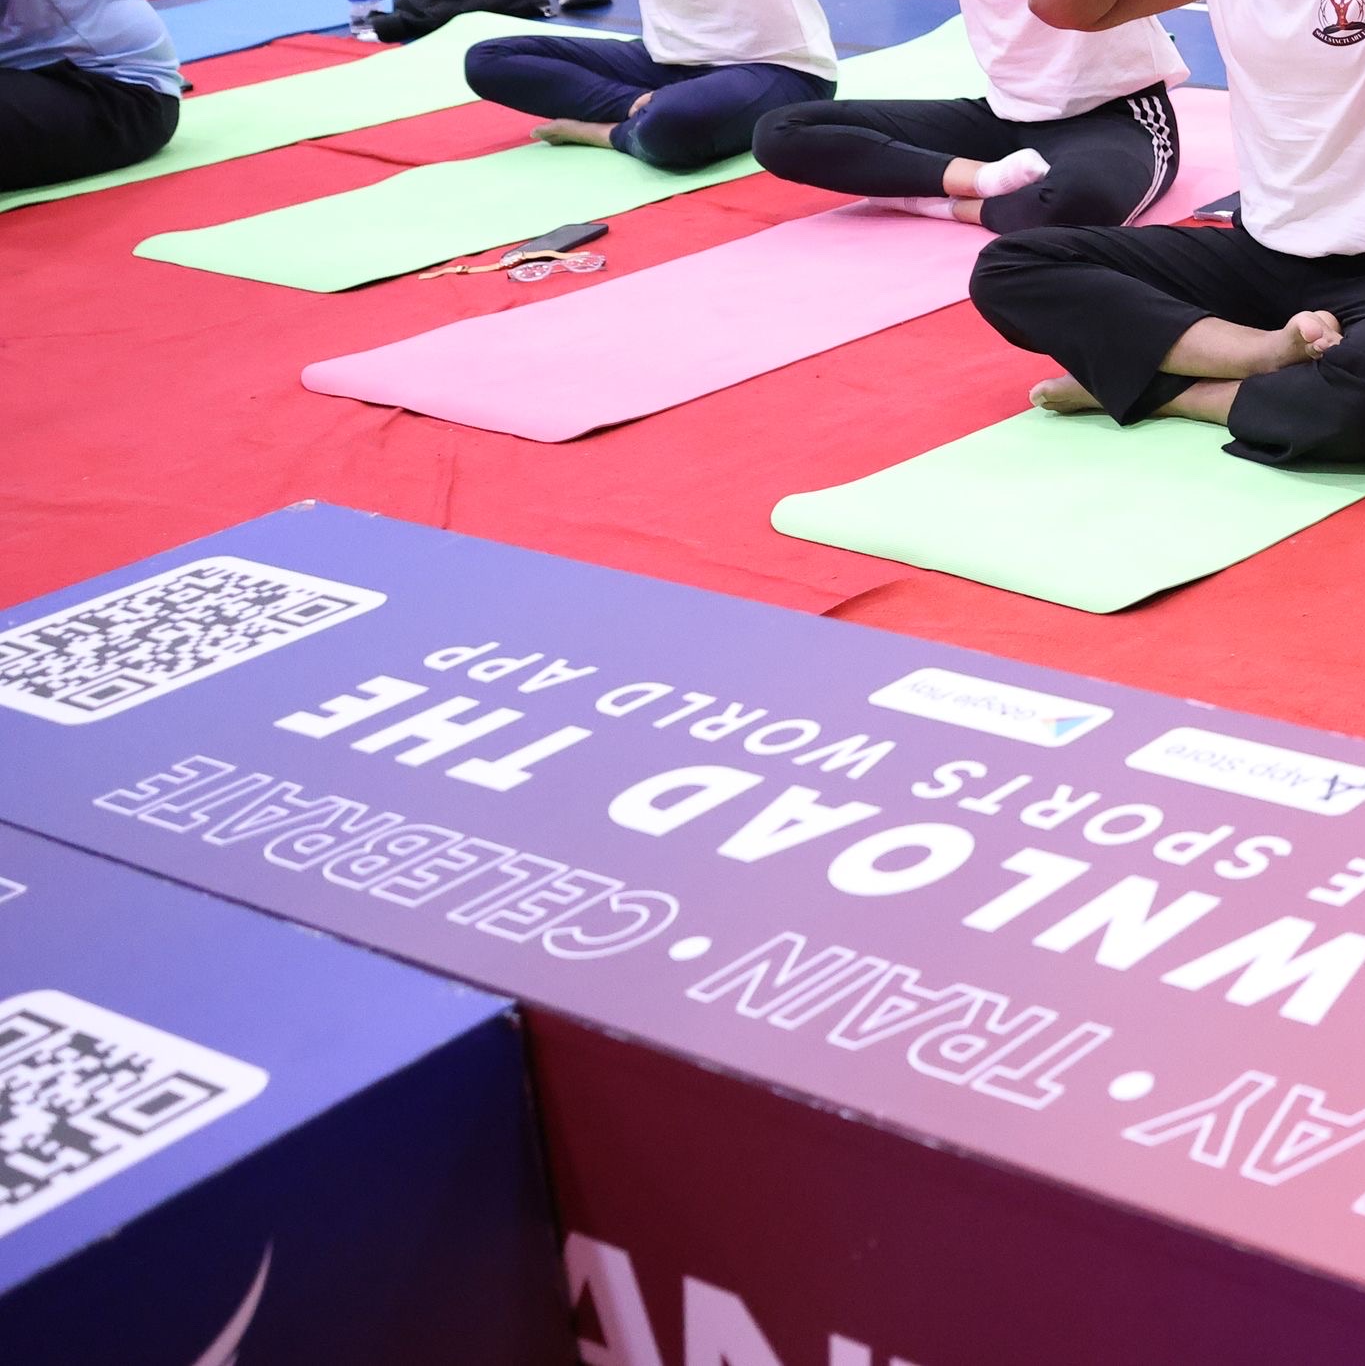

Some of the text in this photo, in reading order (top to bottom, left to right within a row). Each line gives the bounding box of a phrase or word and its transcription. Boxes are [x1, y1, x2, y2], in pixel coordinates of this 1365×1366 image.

[423, 641, 599, 694] APP
[951, 694, 1037, 723] Google
[273, 675, 593, 792] THE
[595, 681, 896, 779] WORLD
[1163, 742, 1309, 789] App Store
[92, 755, 680, 959] CELEBRATE
[911, 760, 1292, 879] SPORTS
[686, 931, 1115, 1111] TRAIN
